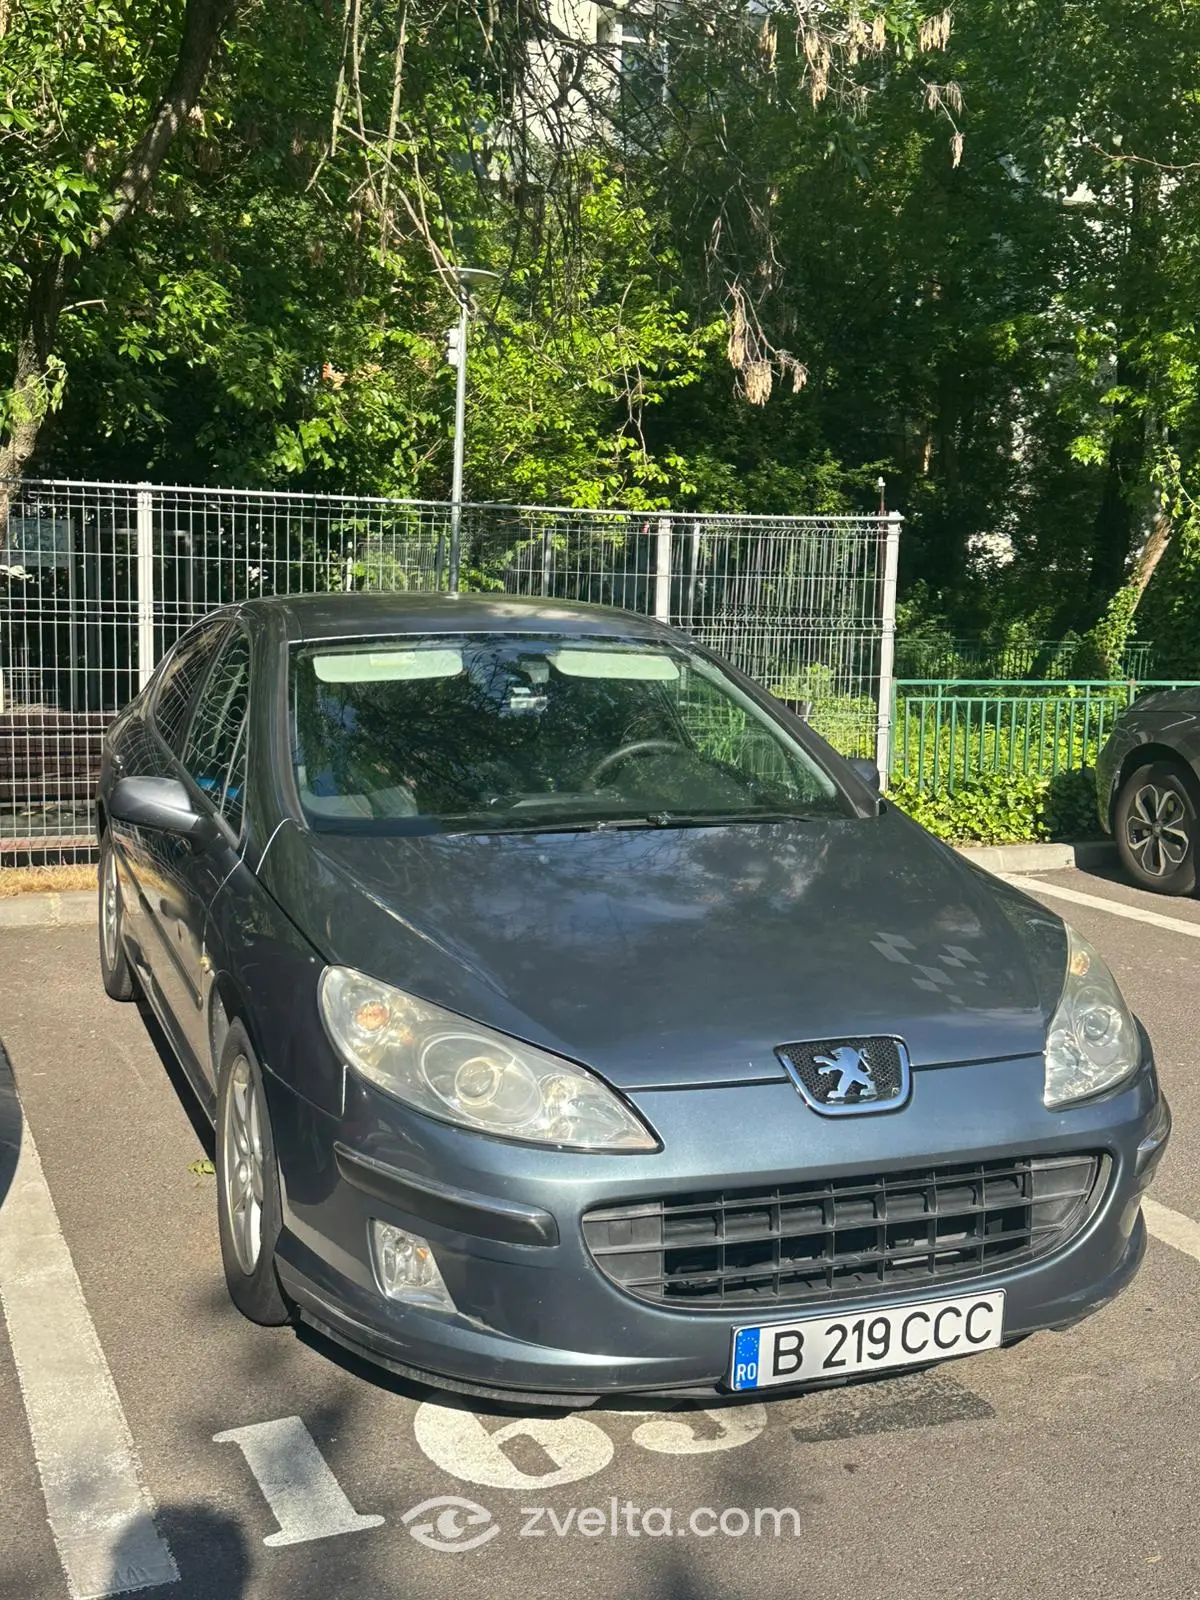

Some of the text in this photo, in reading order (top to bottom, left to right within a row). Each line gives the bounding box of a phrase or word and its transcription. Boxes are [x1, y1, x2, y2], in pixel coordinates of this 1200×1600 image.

[772, 1302, 994, 1377] B 219 CCC
[736, 1363, 756, 1381] RO
